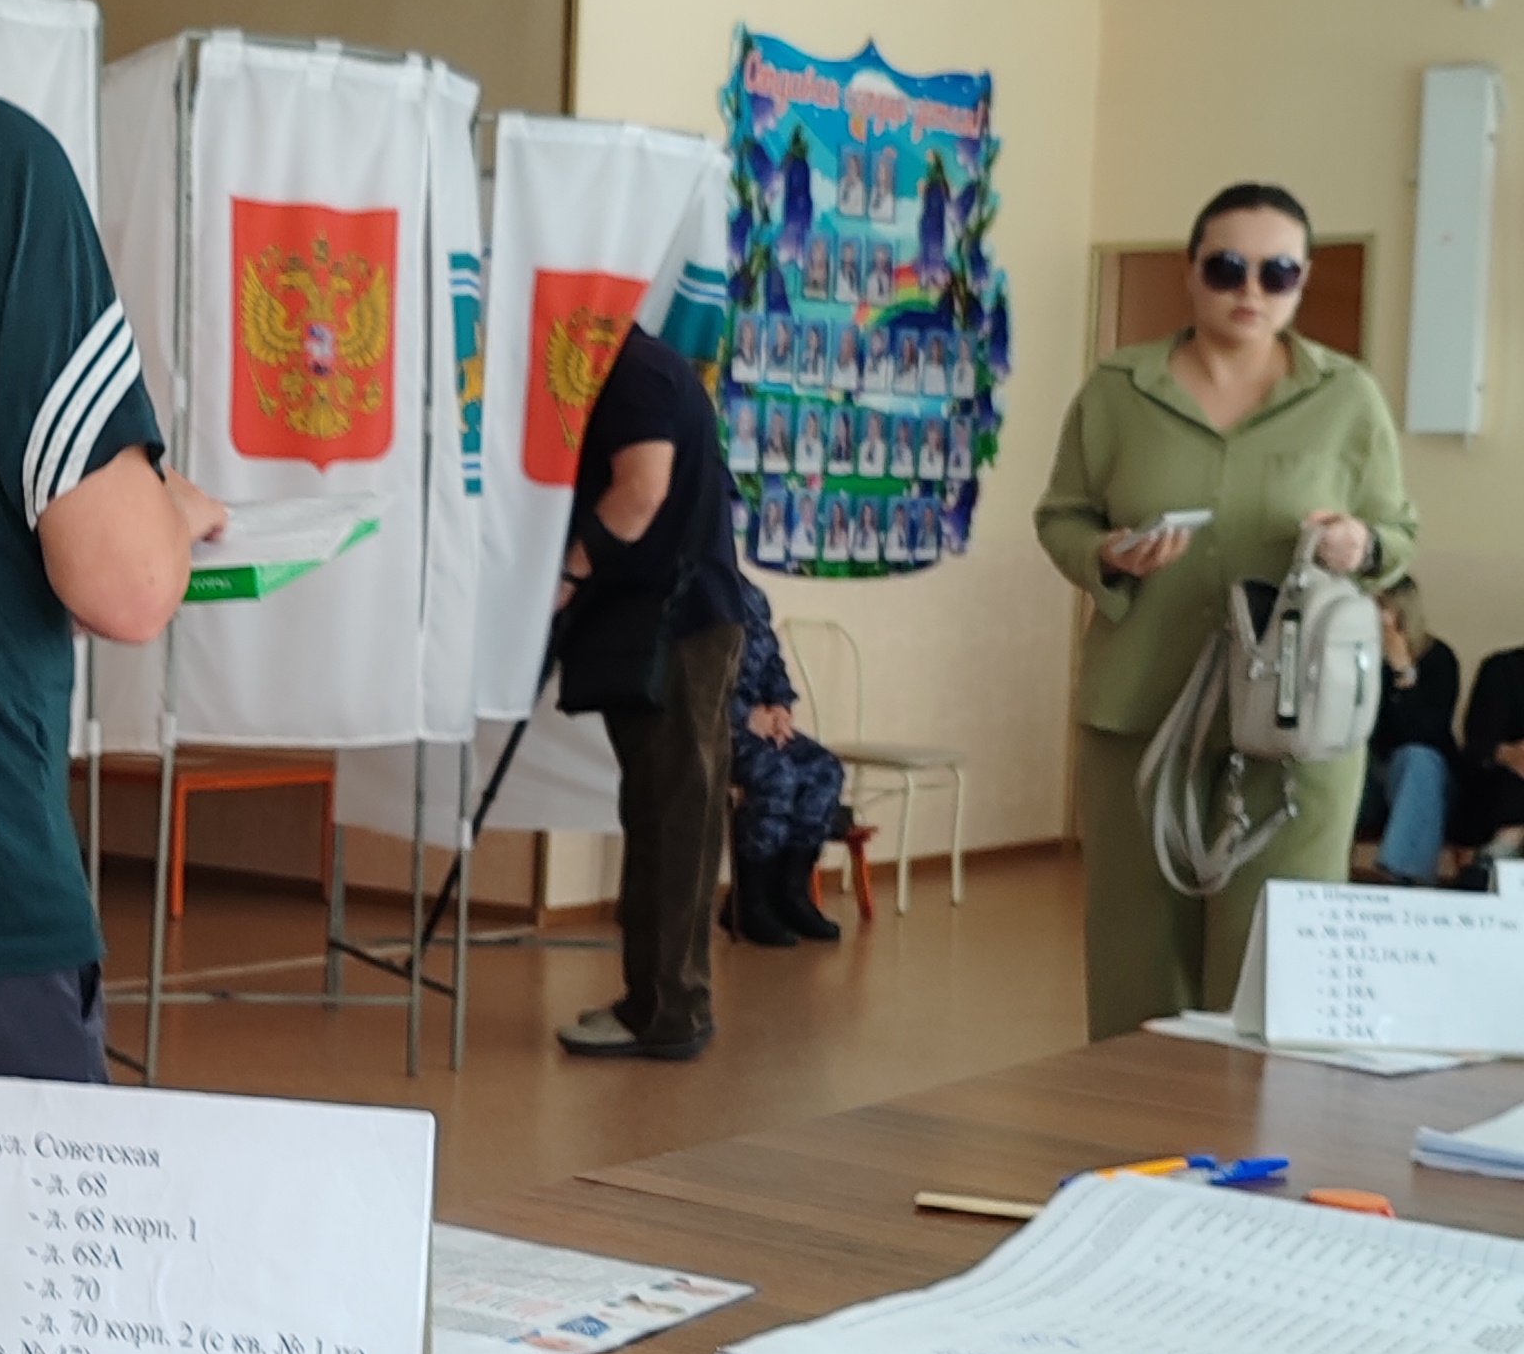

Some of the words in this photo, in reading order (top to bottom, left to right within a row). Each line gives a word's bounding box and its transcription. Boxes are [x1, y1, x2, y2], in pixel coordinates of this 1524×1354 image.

[33, 1130, 160, 1168] Советская
[76, 1170, 108, 1198] 68
[74, 1205, 106, 1233] 68
[111, 1214, 178, 1244] корп.
[188, 1215, 197, 1243] 1
[72, 1240, 124, 1270] 68А
[70, 1273, 102, 1303] 70
[68, 1308, 100, 1338] 70
[104, 1319, 172, 1350] корп.
[178, 1320, 194, 1348] 2
